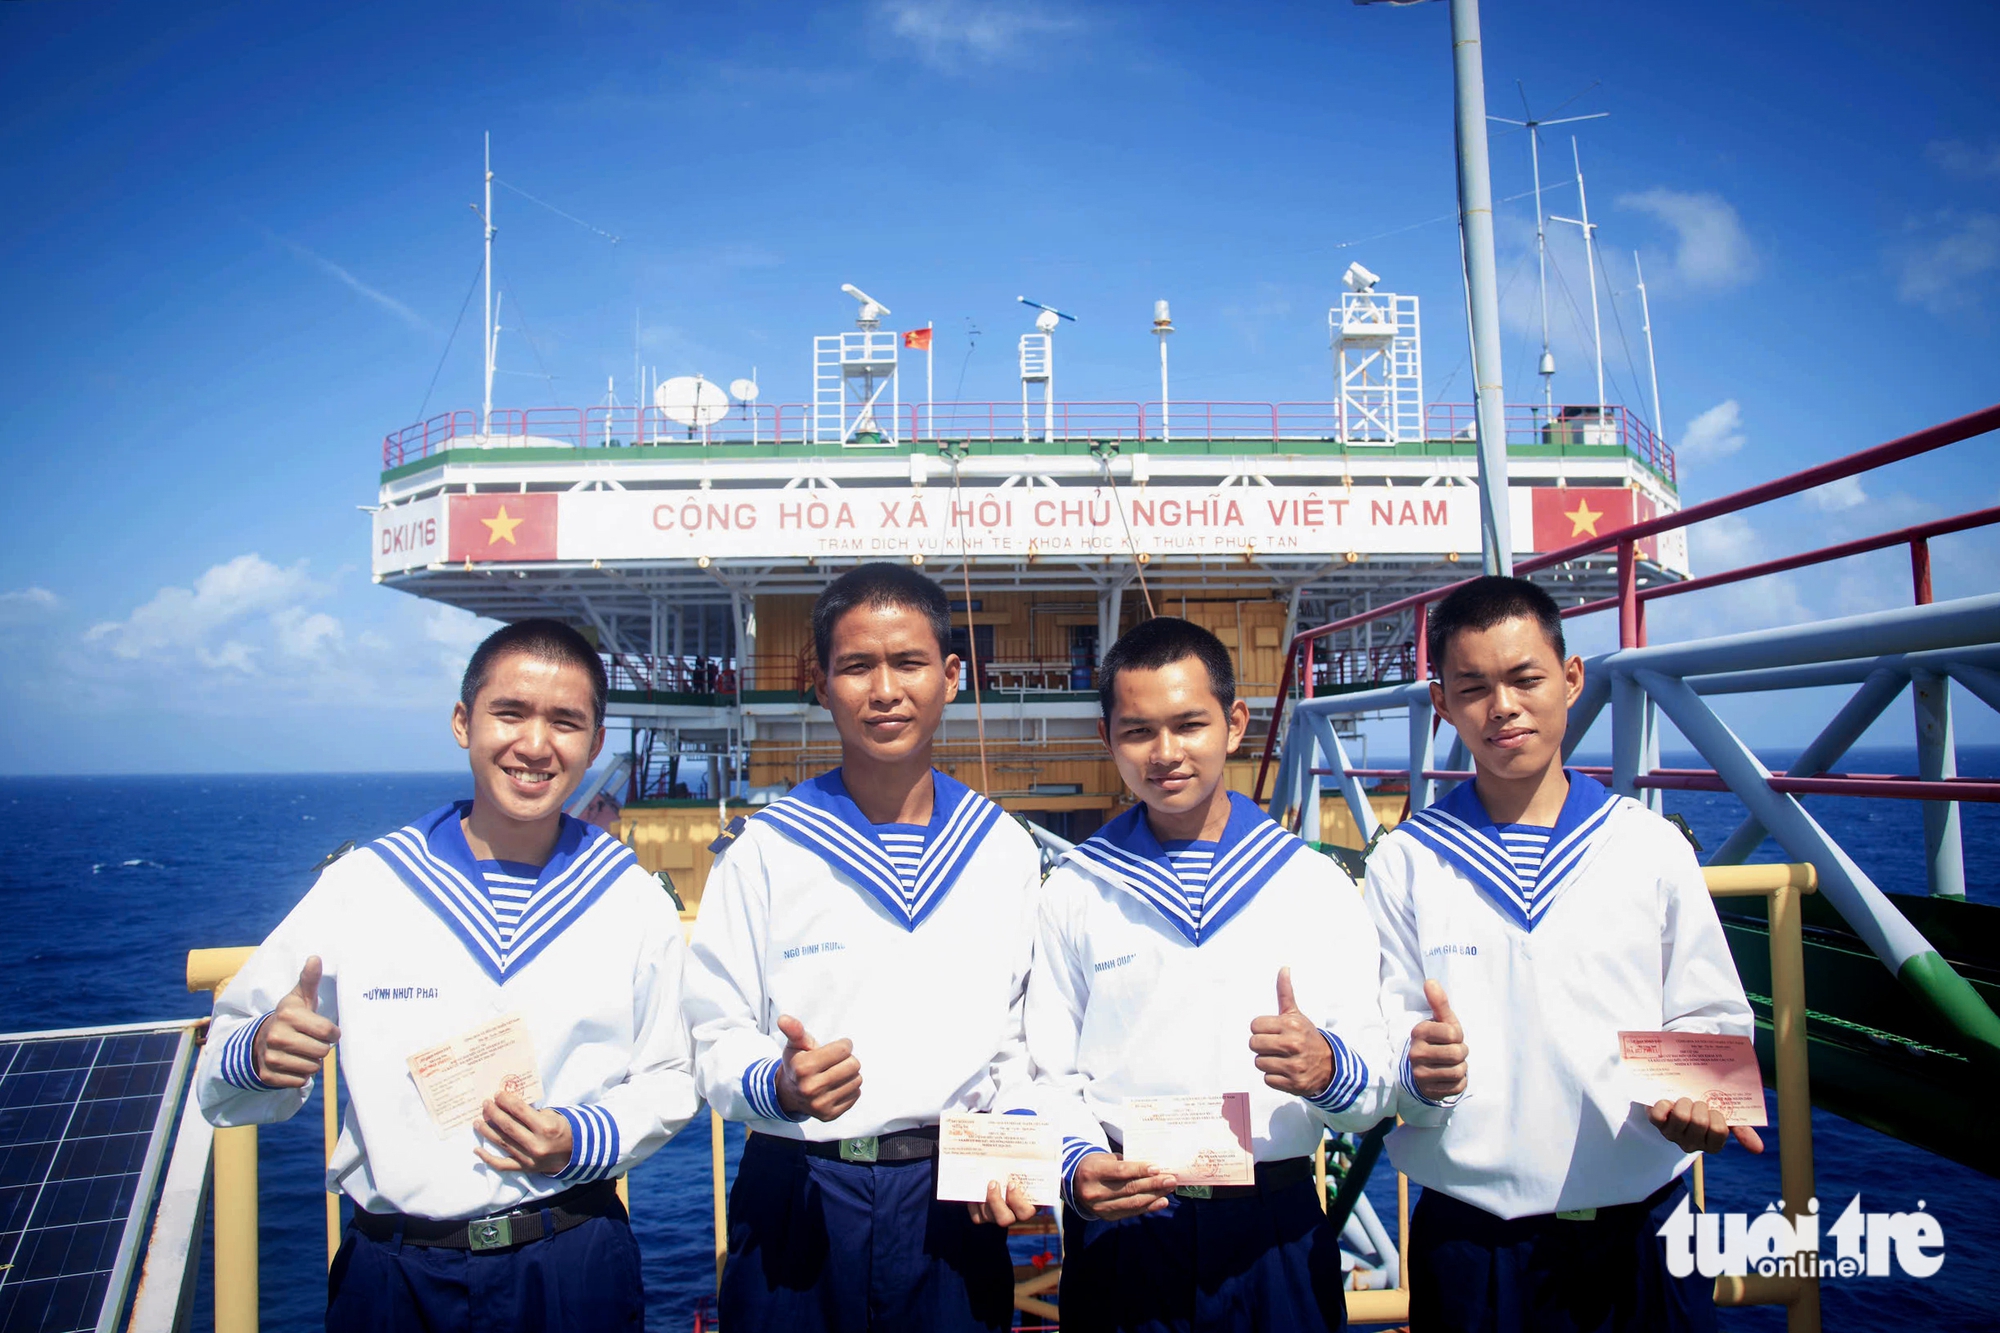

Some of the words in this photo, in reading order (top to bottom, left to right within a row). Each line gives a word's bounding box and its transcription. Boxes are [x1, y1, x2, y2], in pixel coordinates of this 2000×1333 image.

[652, 495, 758, 538] CỘNG
[778, 493, 856, 530] HÒA
[880, 494, 929, 528] XÃ
[950, 492, 1013, 534] HỘI
[1034, 488, 1112, 527] CHỦ
[1132, 493, 1245, 527] NGHĨA
[1267, 491, 1350, 533] VIỆT
[1370, 499, 1448, 526] NAM
[946, 537, 983, 549] KINH
[1029, 536, 1072, 549] KHOA
[1094, 959, 1116, 973] MINH
